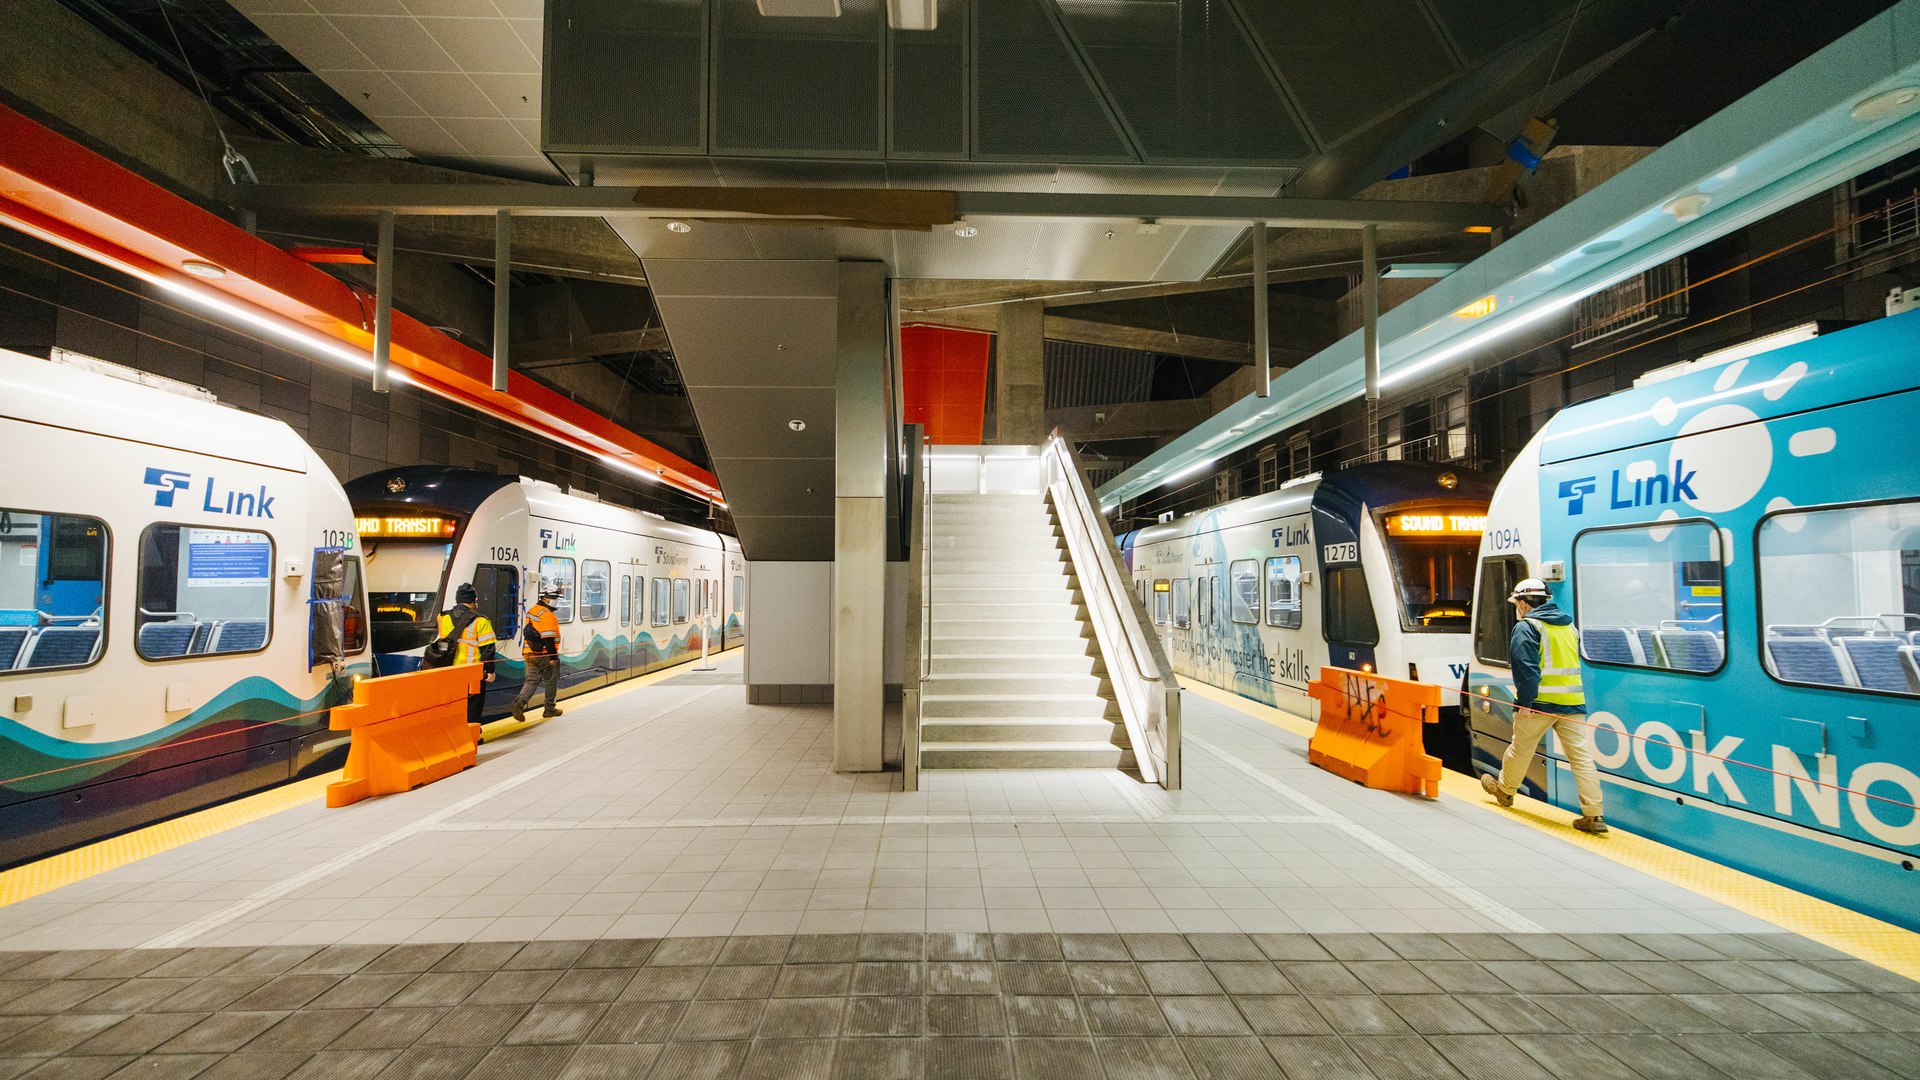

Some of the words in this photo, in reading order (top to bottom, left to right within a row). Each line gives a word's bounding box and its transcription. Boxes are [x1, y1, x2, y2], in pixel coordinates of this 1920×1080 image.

[1610, 459, 1698, 510] Link
[203, 477, 275, 519] Link
[355, 518, 379, 533] UND
[386, 518, 440, 533] TRANSIT
[1401, 516, 1443, 531] SOUND
[1449, 516, 1488, 531] TRANS
[323, 529, 354, 549] 103B
[555, 531, 576, 551] Link
[1286, 523, 1310, 546] Link
[1488, 528, 1521, 551] 109A
[490, 546, 520, 562] 105A
[1325, 544, 1356, 561] 127B
[1225, 647, 1257, 670] master
[1257, 639, 1276, 675] the
[1280, 647, 1311, 684] skills
[1772, 744, 1920, 846] NO
